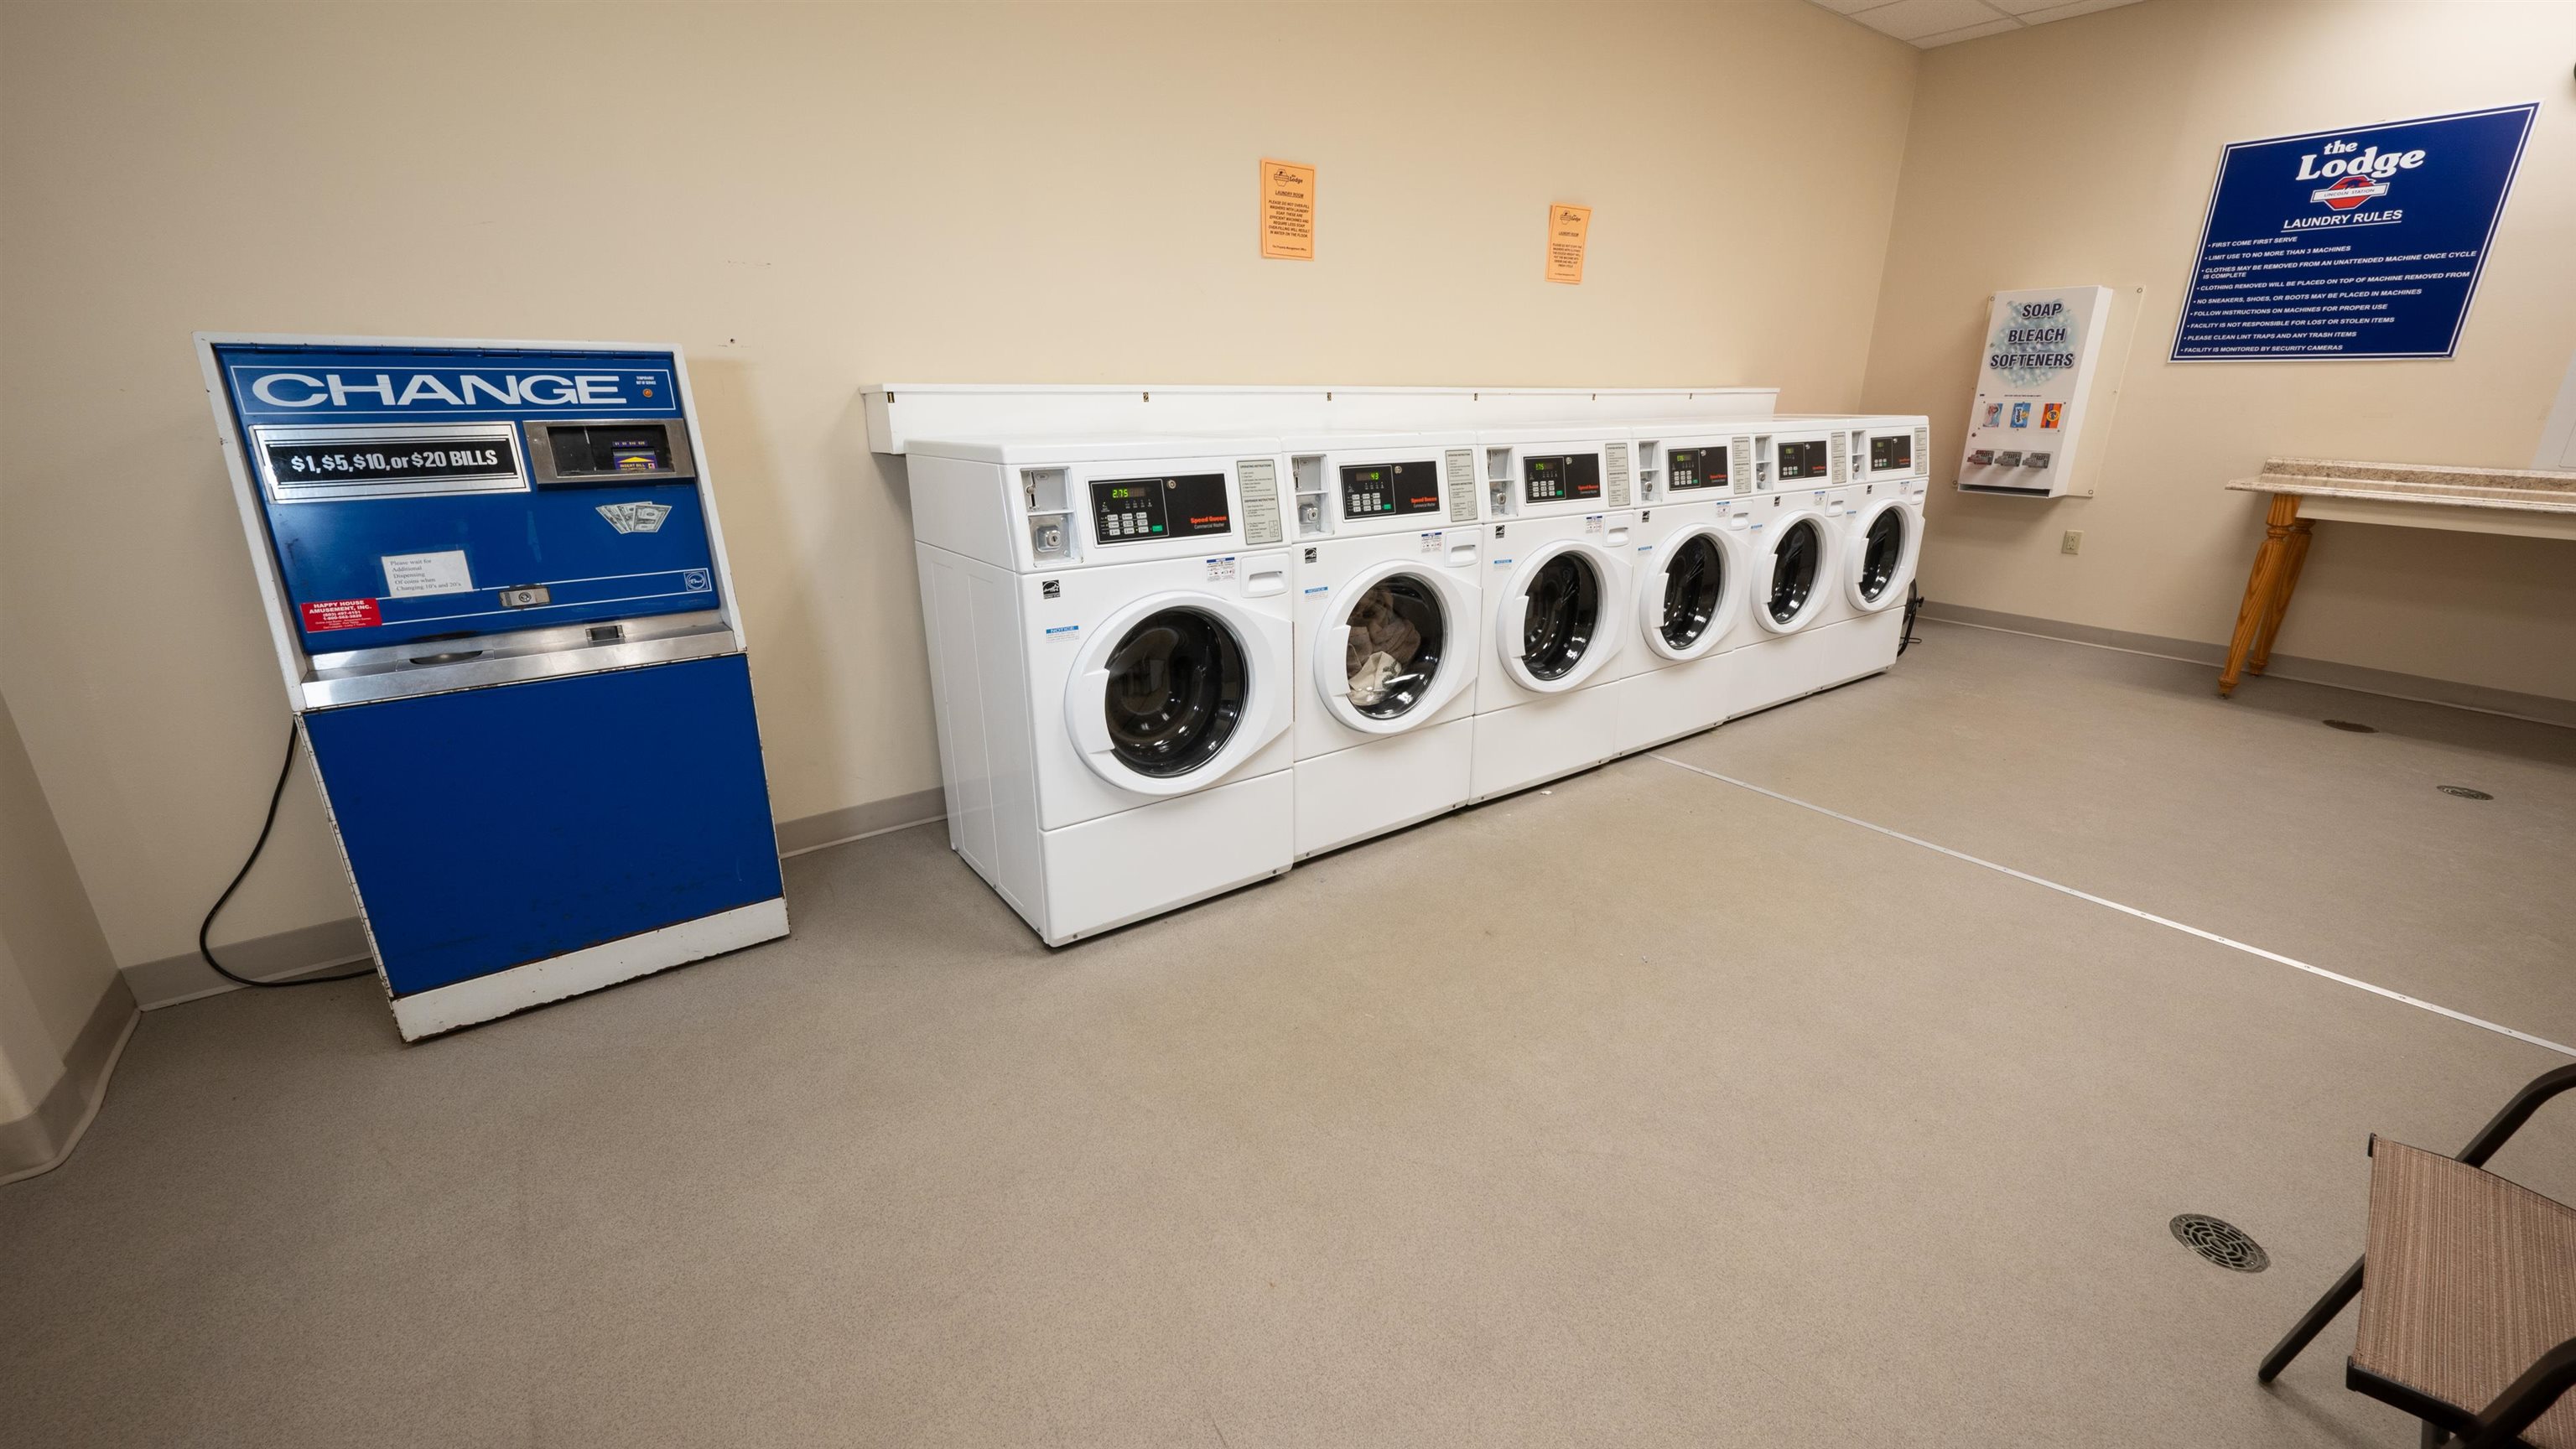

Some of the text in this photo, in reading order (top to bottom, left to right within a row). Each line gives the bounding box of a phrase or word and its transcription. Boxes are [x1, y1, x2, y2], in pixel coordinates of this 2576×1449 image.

[2324, 140, 2358, 155] the
[2296, 146, 2426, 180] Lodge
[2283, 210, 2403, 229] LAUNDRY RULES
[2333, 257, 2384, 265] UNATTENDED
[2023, 304, 2062, 317] SOAP
[2008, 328, 2065, 342] BLEACH
[1991, 353, 2074, 367] SOFTENERS
[252, 373, 626, 407] CHANGE
[888, 392, 893, 402] 1
[411, 451, 446, 467] $20
[449, 449, 497, 466] BILLS
[1113, 489, 1128, 498] 2.75
[309, 605, 356, 614] AMUSEMENT,
